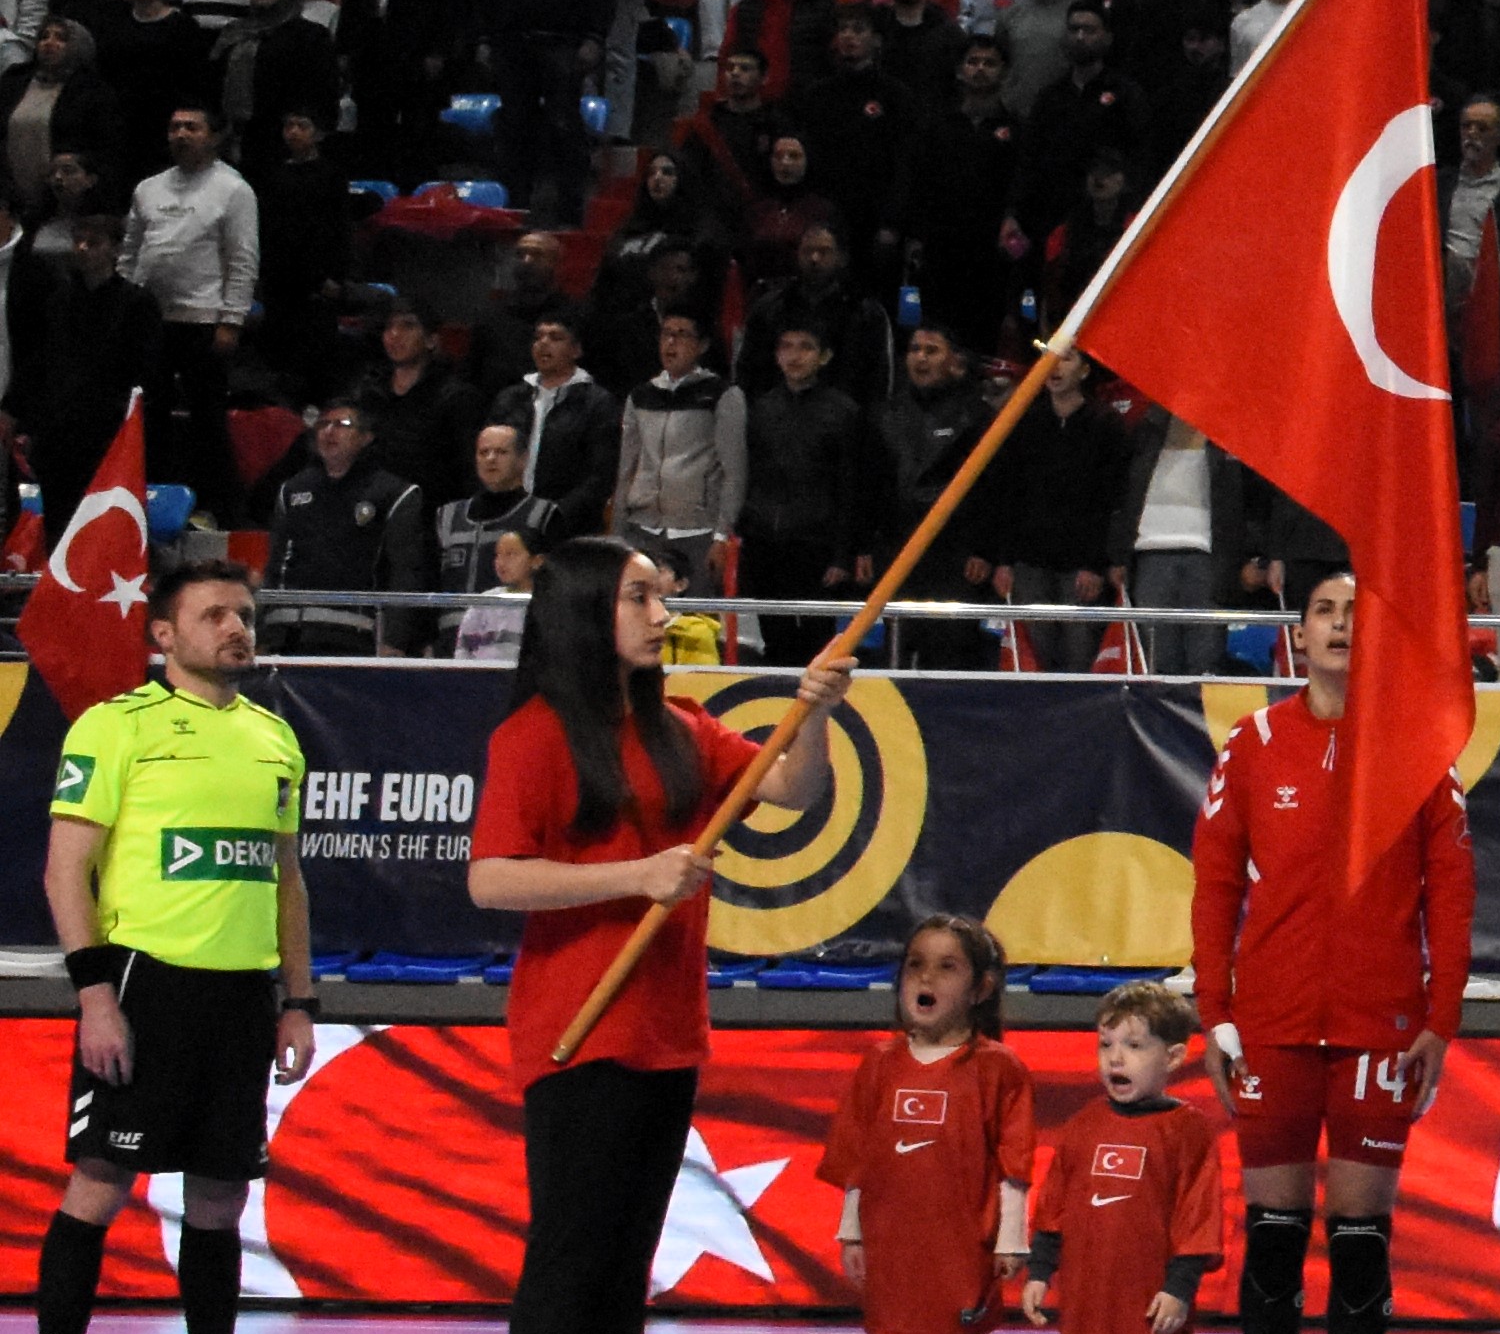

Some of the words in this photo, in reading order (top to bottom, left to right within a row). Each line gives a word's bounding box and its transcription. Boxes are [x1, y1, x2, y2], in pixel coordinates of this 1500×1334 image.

[304, 771, 372, 820] EHF
[380, 772, 475, 823] EURO
[301, 832, 392, 859] WOMEN'S
[397, 834, 431, 860] EHF
[1353, 1052, 1408, 1103] 14
[109, 1130, 144, 1144] EHF
